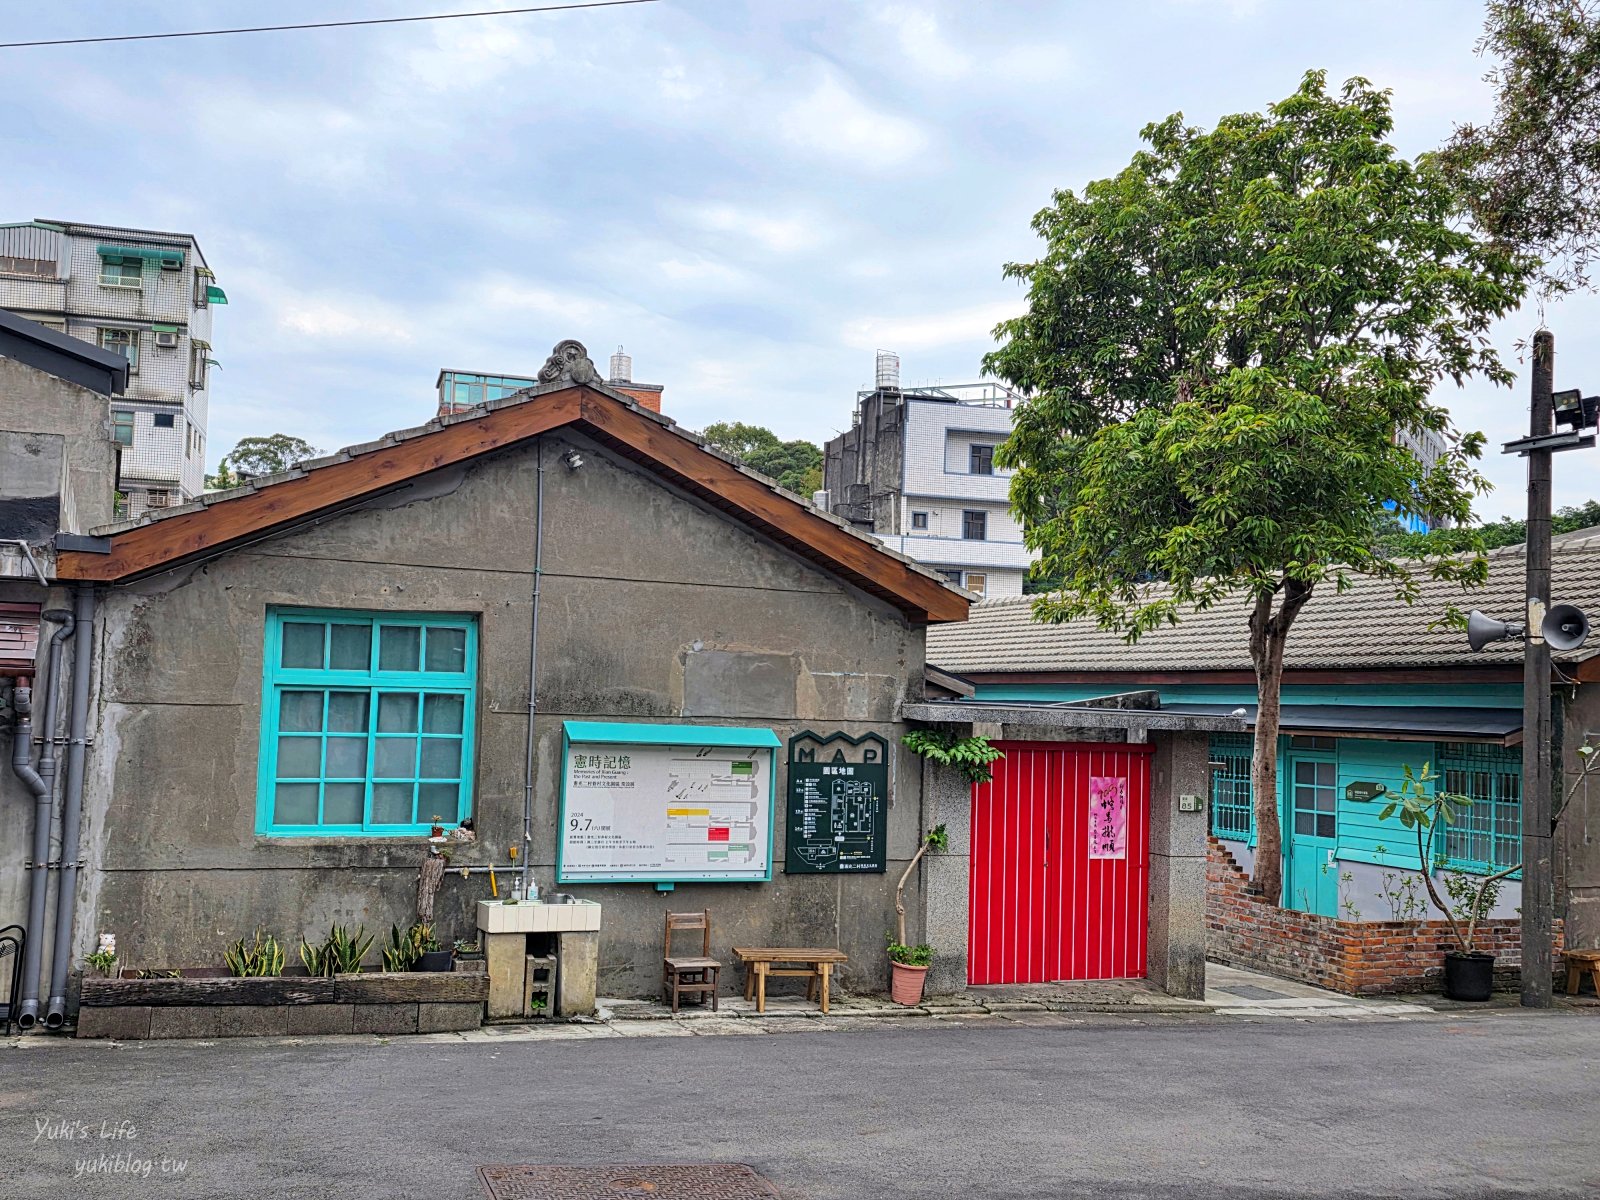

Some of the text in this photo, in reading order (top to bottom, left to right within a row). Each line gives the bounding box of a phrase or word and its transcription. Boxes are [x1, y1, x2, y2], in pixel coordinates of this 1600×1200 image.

[574, 755, 631, 769] 憲時記憶
[798, 747, 878, 763] MAP
[570, 818, 592, 831] 9.7
